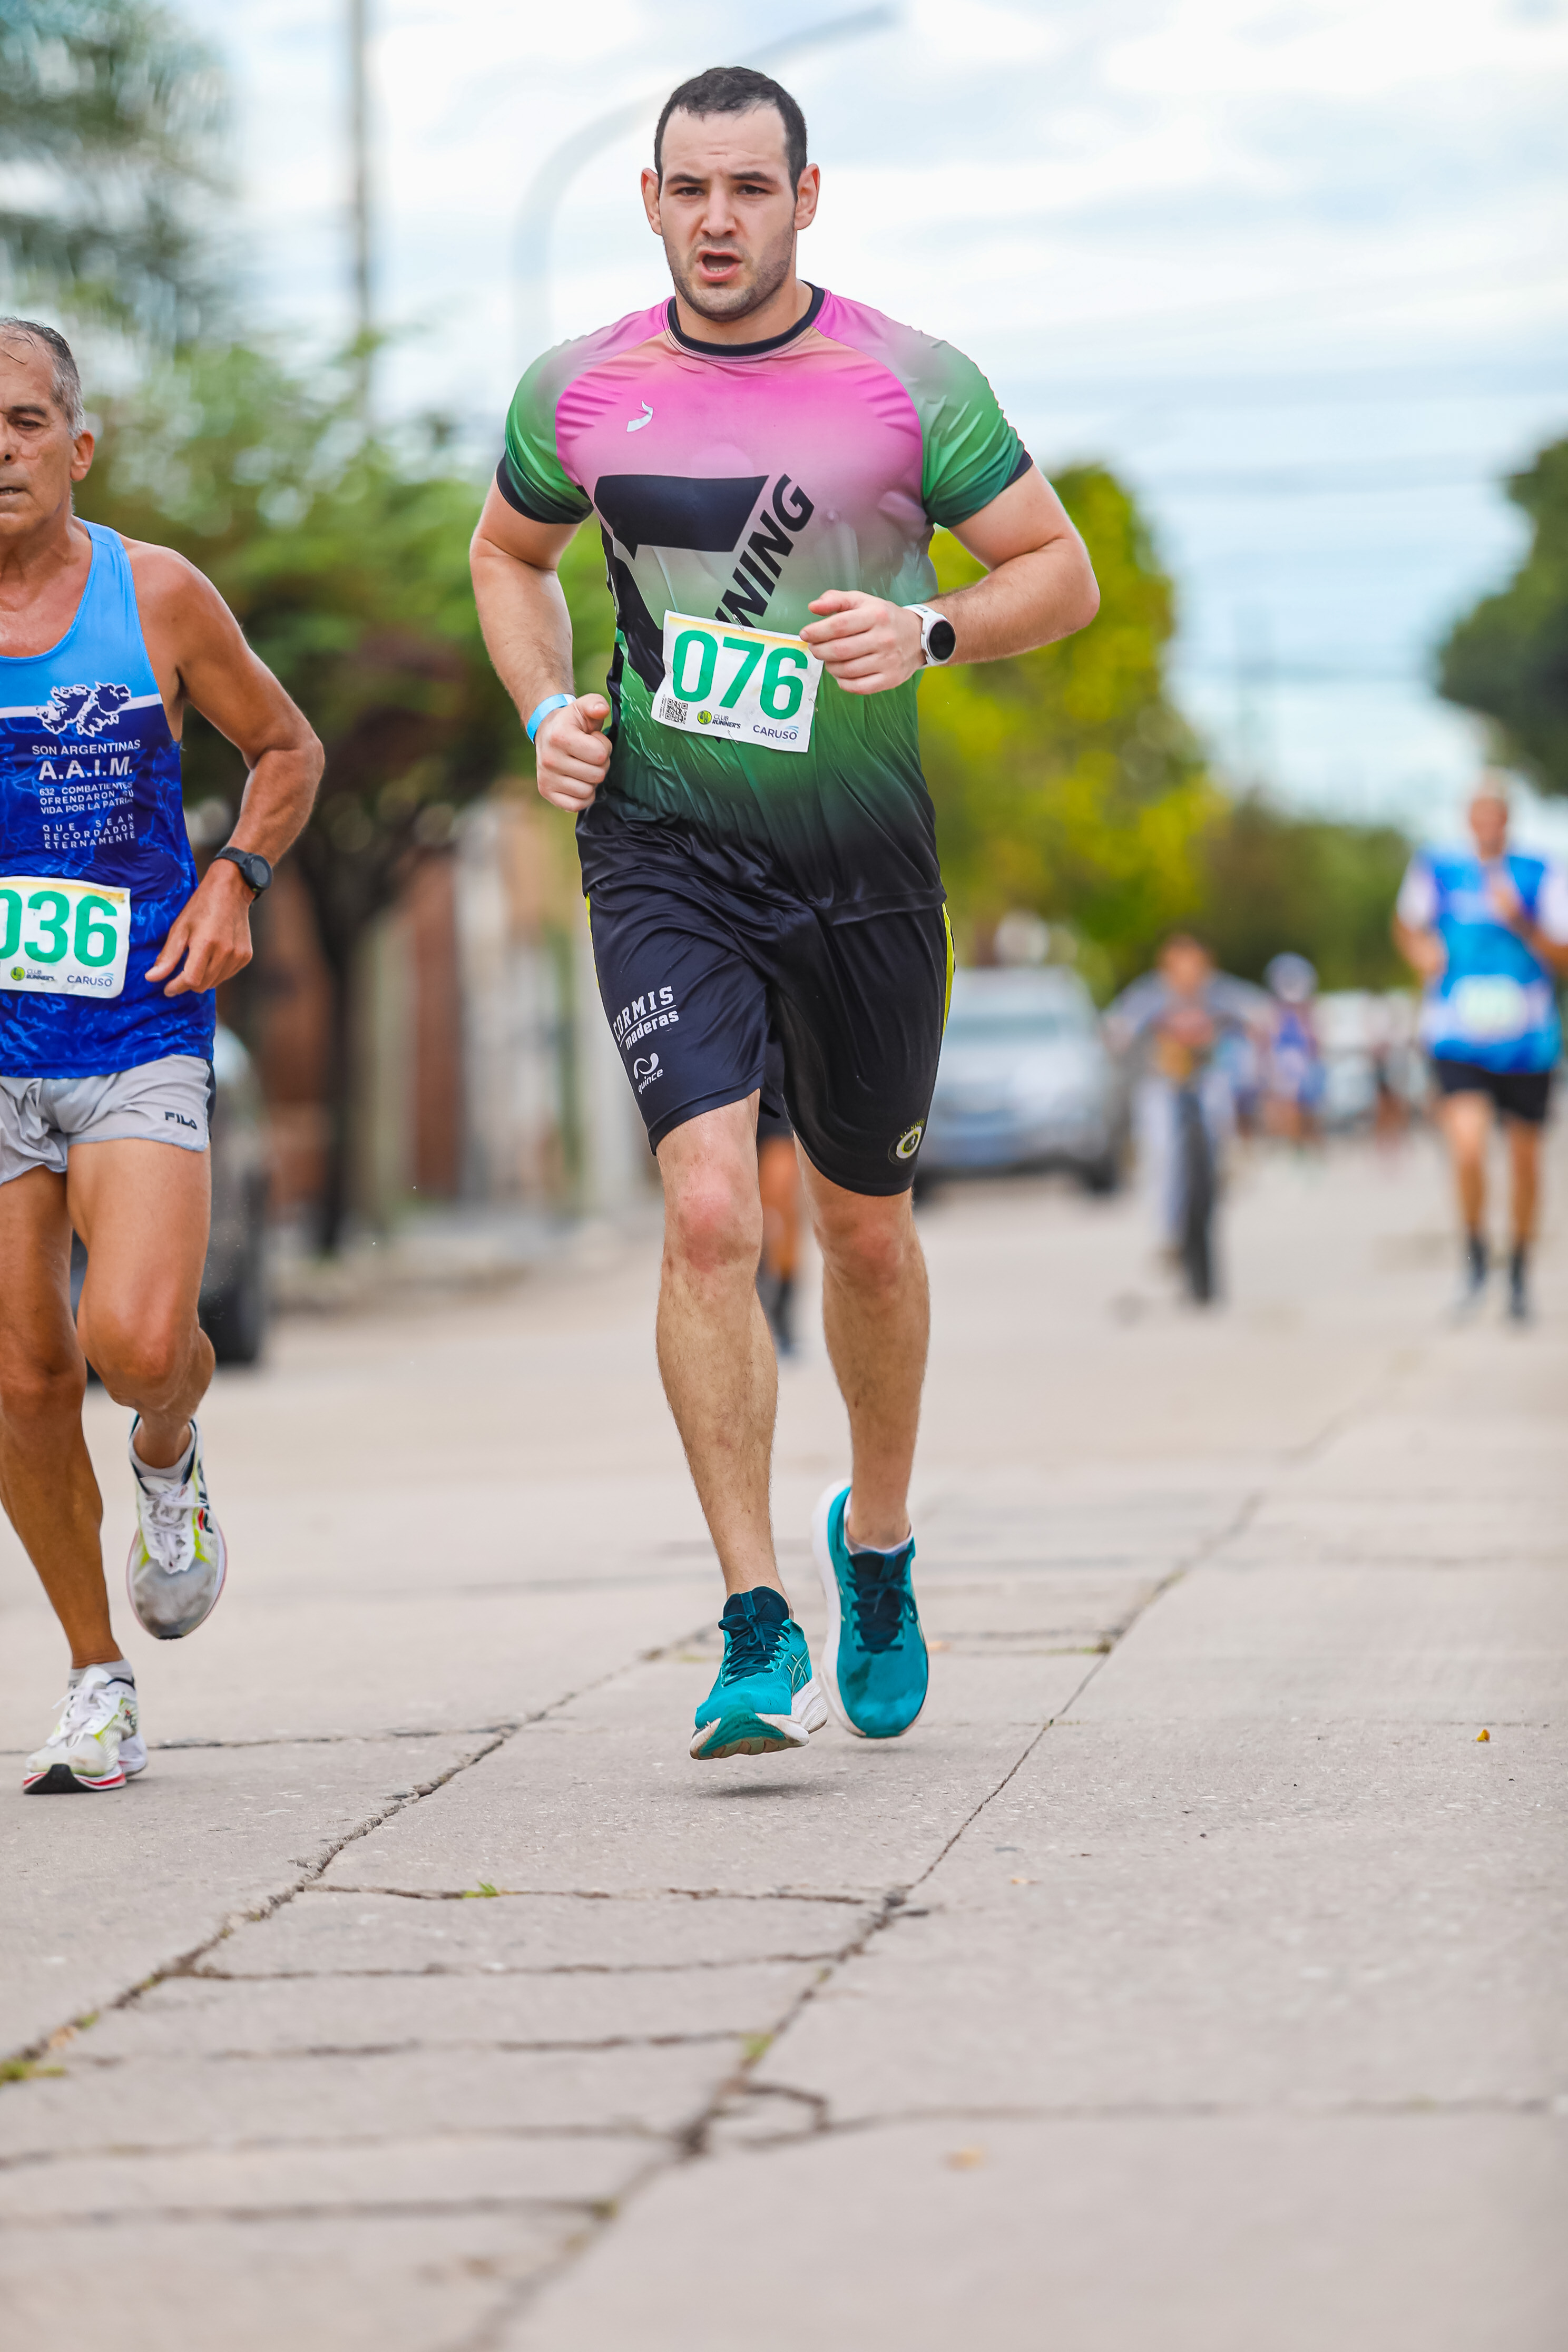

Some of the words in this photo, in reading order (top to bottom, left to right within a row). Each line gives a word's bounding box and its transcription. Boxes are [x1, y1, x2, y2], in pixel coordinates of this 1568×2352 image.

[714, 474, 815, 628] NING
[672, 630, 808, 720] 076
[753, 725, 798, 740] CARUSO
[32, 745, 57, 755] SON
[61, 739, 140, 755] ARGENTINAS
[38, 756, 132, 780] A.A.I.M.
[40, 787, 55, 796] 632
[62, 781, 133, 795] COMBATIENTES
[40, 790, 115, 805] OFRENDARON
[66, 804, 85, 813] POR
[87, 802, 100, 810] LA
[43, 822, 75, 832] QUE
[95, 813, 133, 828] SEAN
[44, 822, 134, 840] RECORDADOS
[45, 831, 135, 849] ETERNAMENTE
[67, 975, 113, 987] CARUSO
[613, 986, 674, 1042] CORMIS
[625, 1011, 679, 1050] maderas
[638, 1069, 663, 1094] quince
[165, 1111, 198, 1130] FILA
